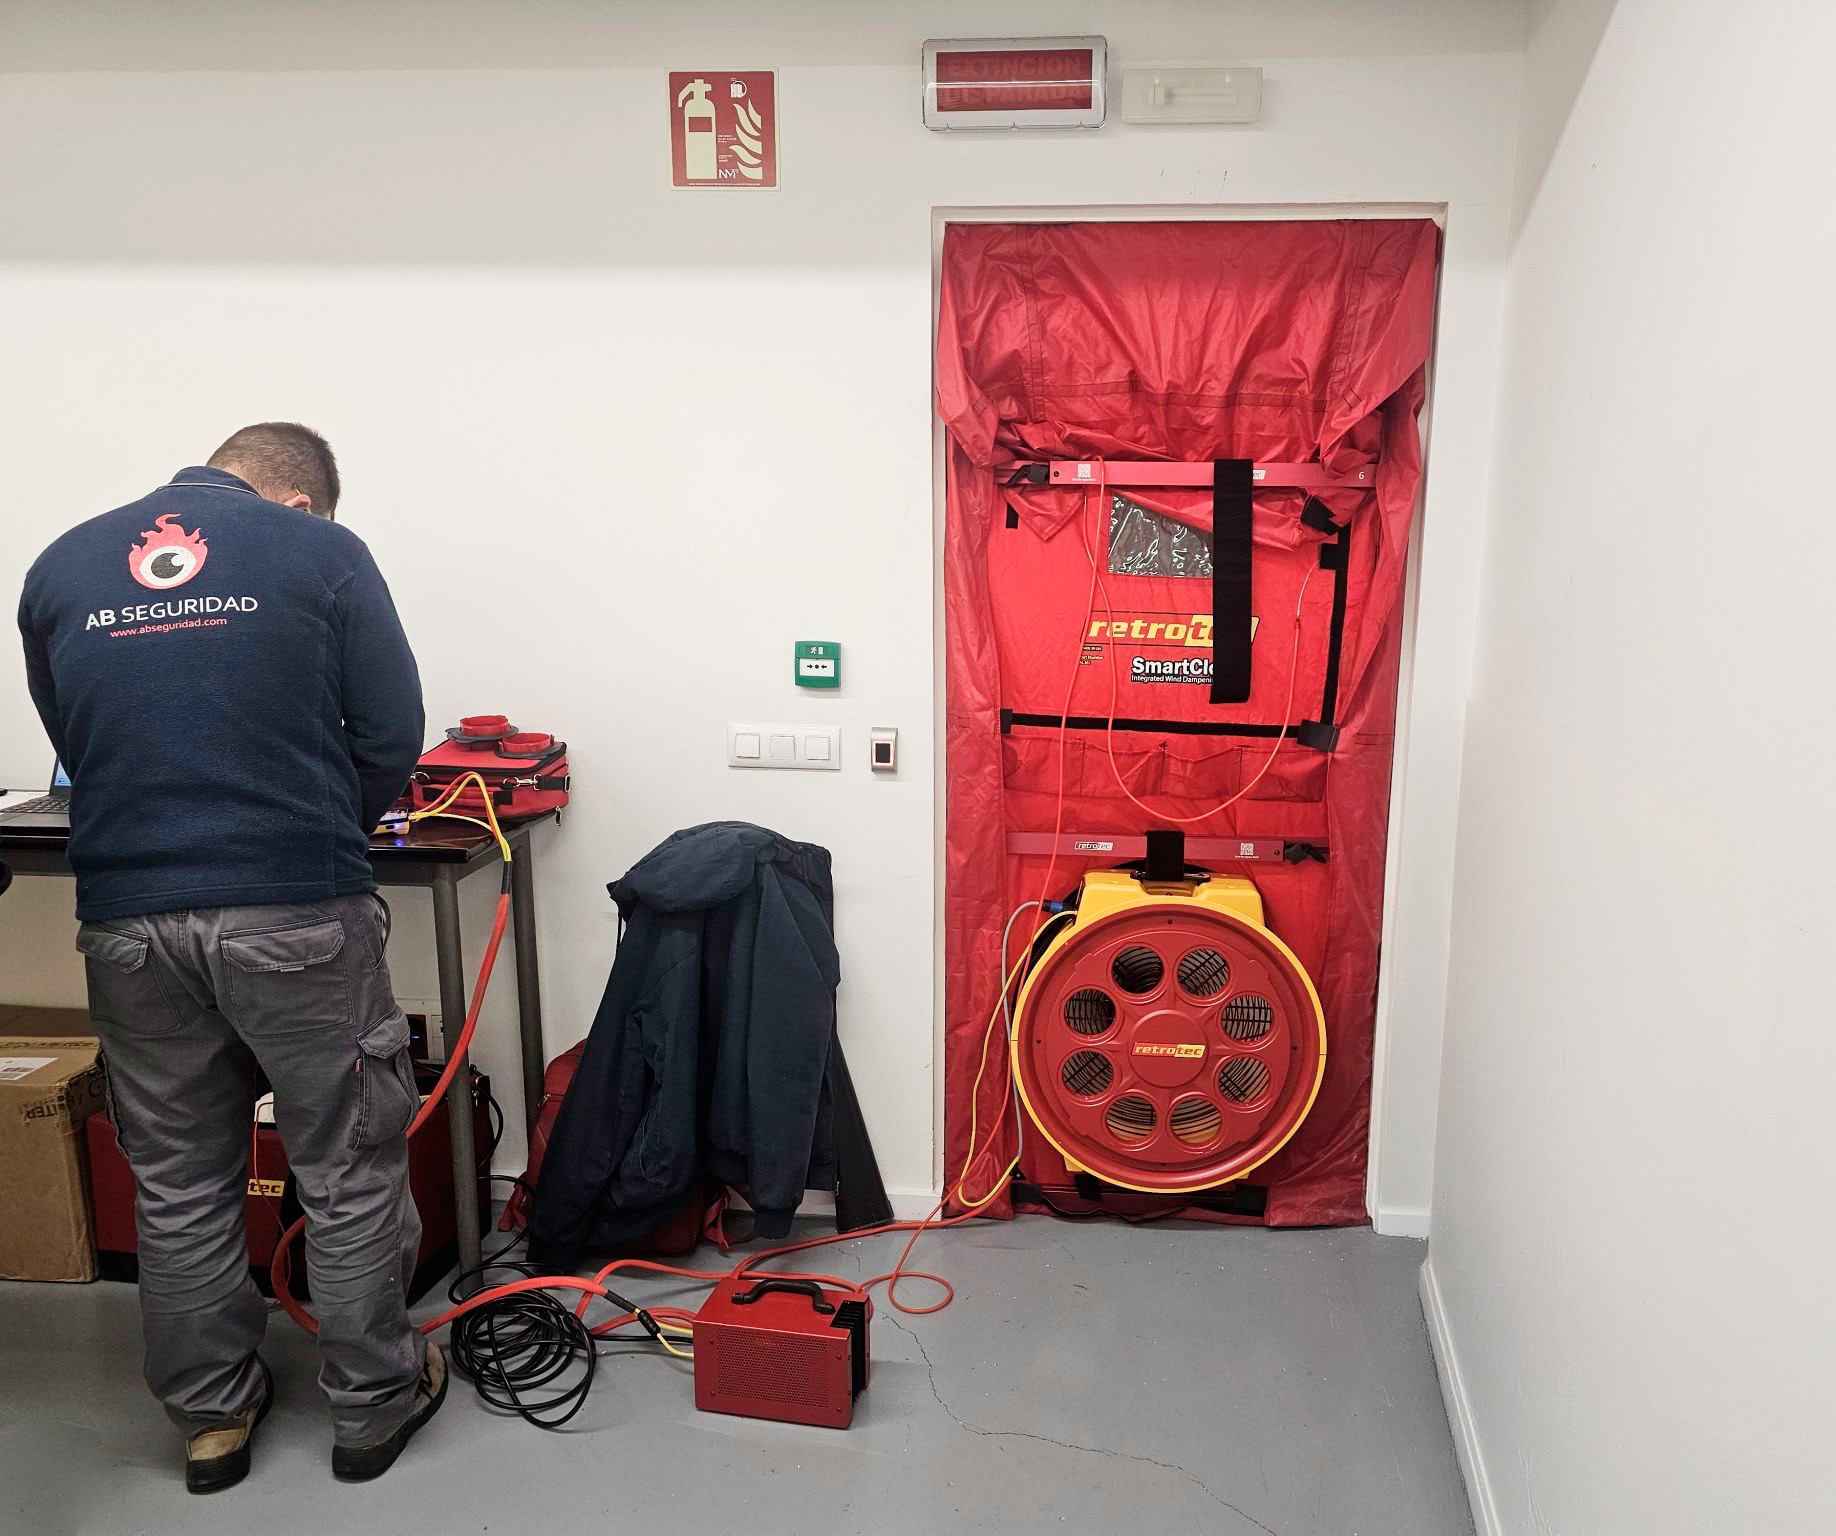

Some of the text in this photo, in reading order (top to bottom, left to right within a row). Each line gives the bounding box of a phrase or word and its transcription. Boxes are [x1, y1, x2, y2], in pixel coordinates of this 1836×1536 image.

[1358, 471, 1365, 480] 6
[85, 596, 258, 630] AB SEGURIDAD
[110, 618, 227, 638] www.abseguridad.com
[1131, 674, 1213, 684] Integrated Wind Dampeni
[1134, 1044, 1203, 1056] retrotec
